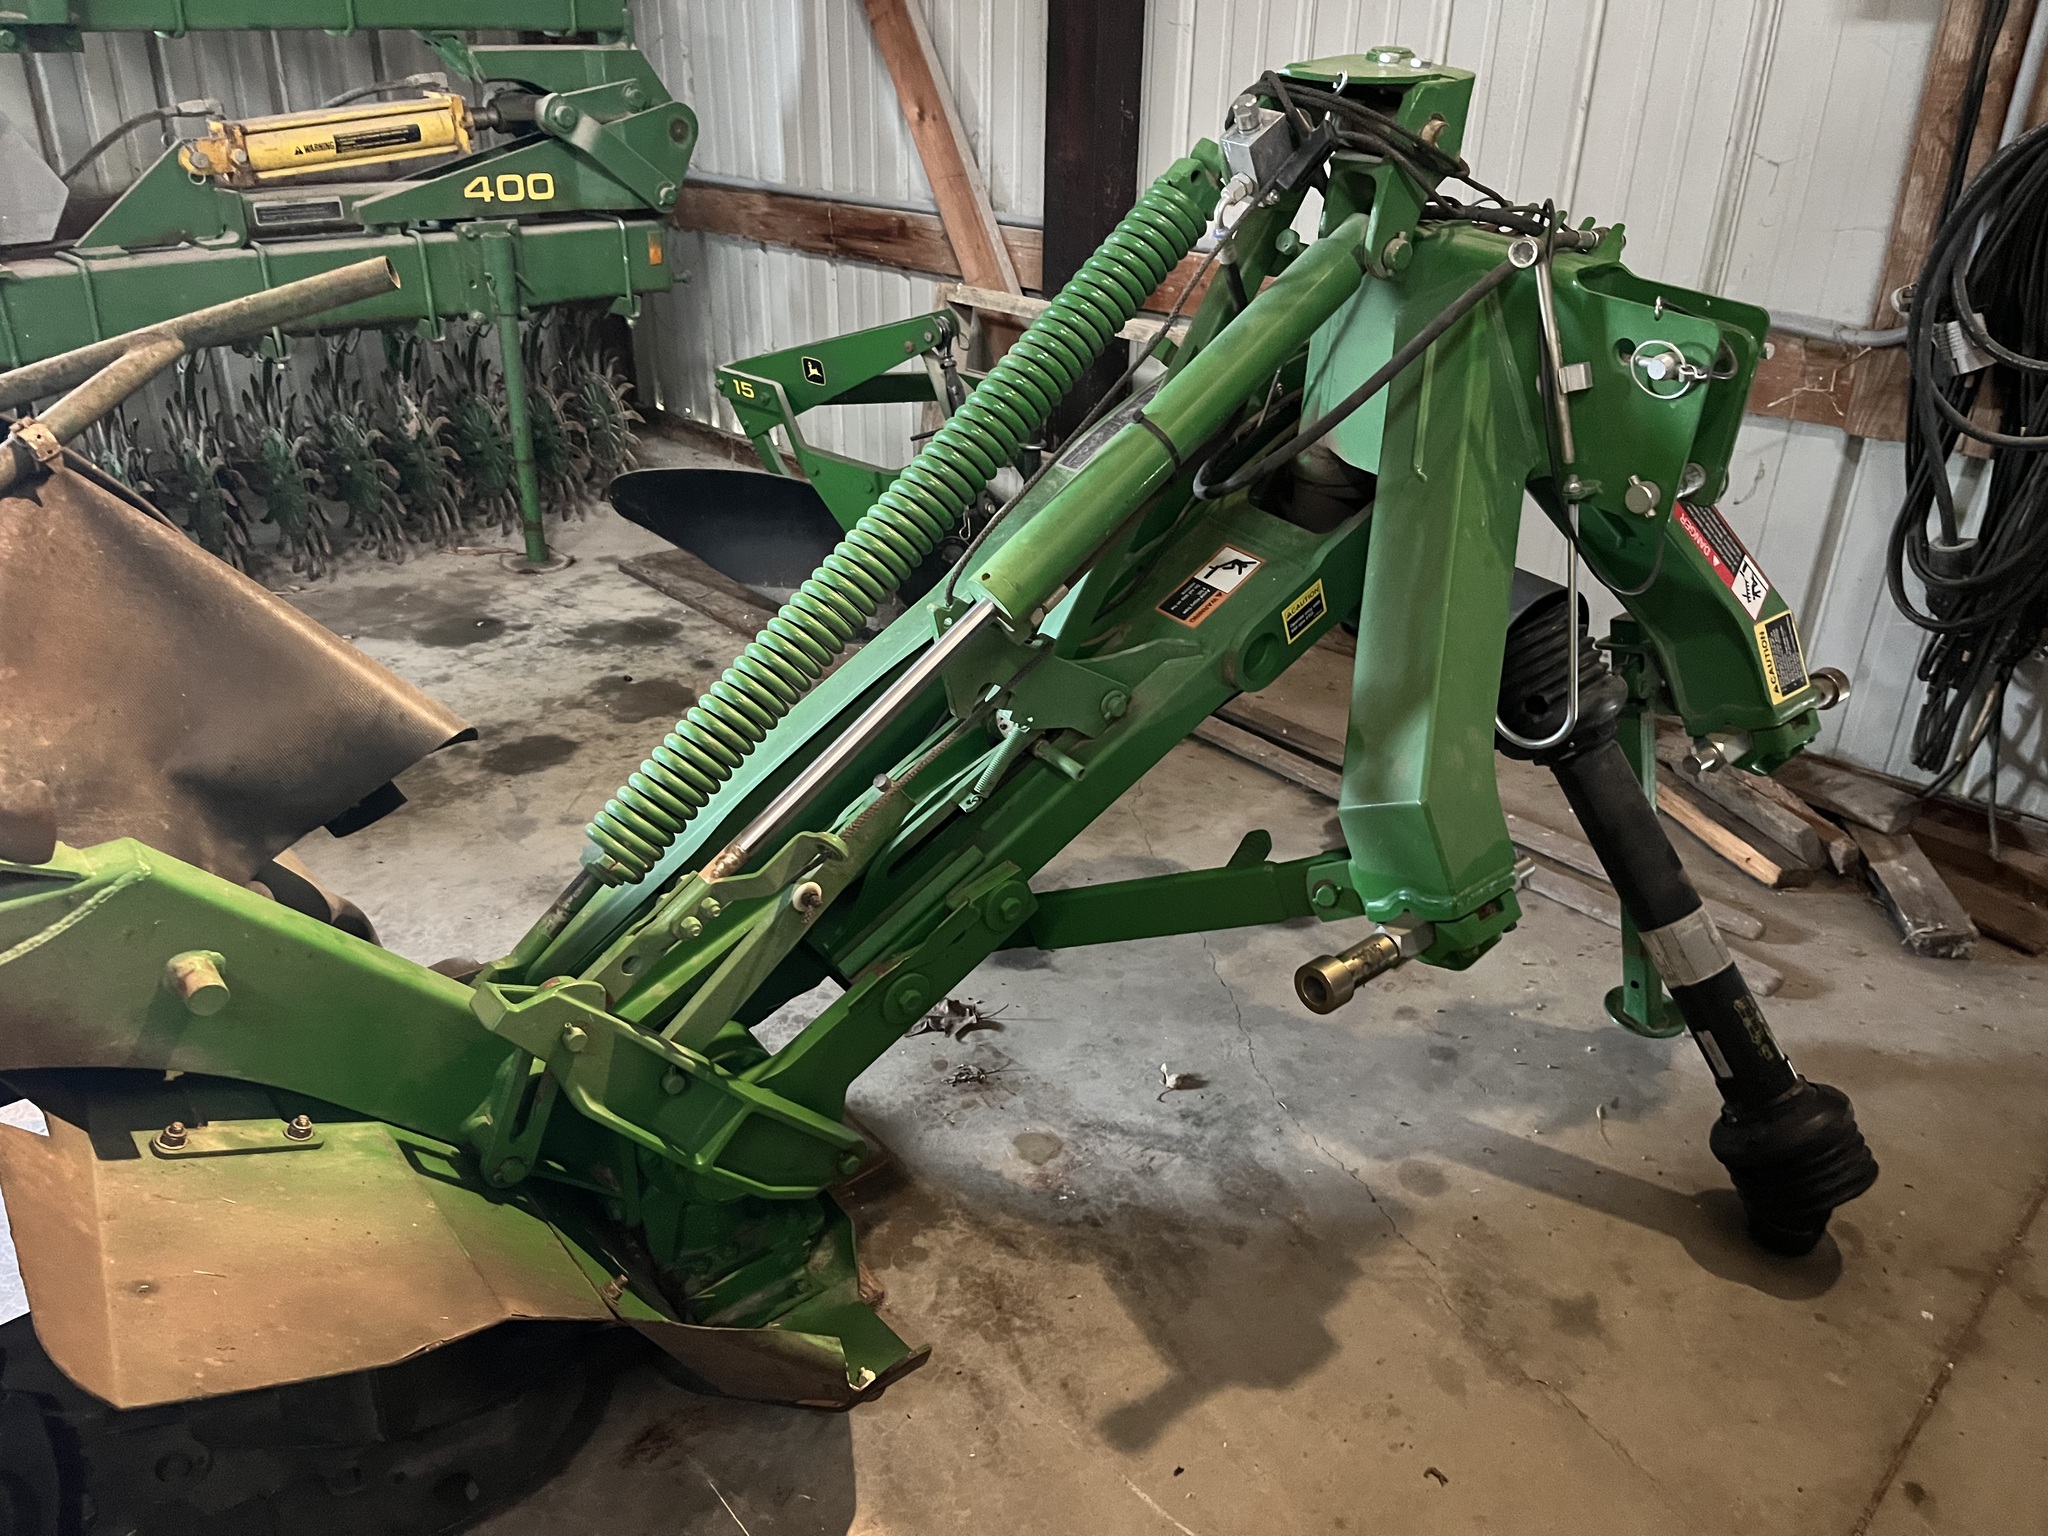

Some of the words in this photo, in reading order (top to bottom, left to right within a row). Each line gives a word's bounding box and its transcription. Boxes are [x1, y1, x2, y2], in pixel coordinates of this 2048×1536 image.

[464, 172, 555, 202] 400
[732, 379, 755, 399] 15
[1680, 512, 1711, 557] DANGER
[1189, 599, 1220, 623] WARNING
[1291, 586, 1320, 614] CAUTION
[1759, 631, 1777, 685] CAUTION
